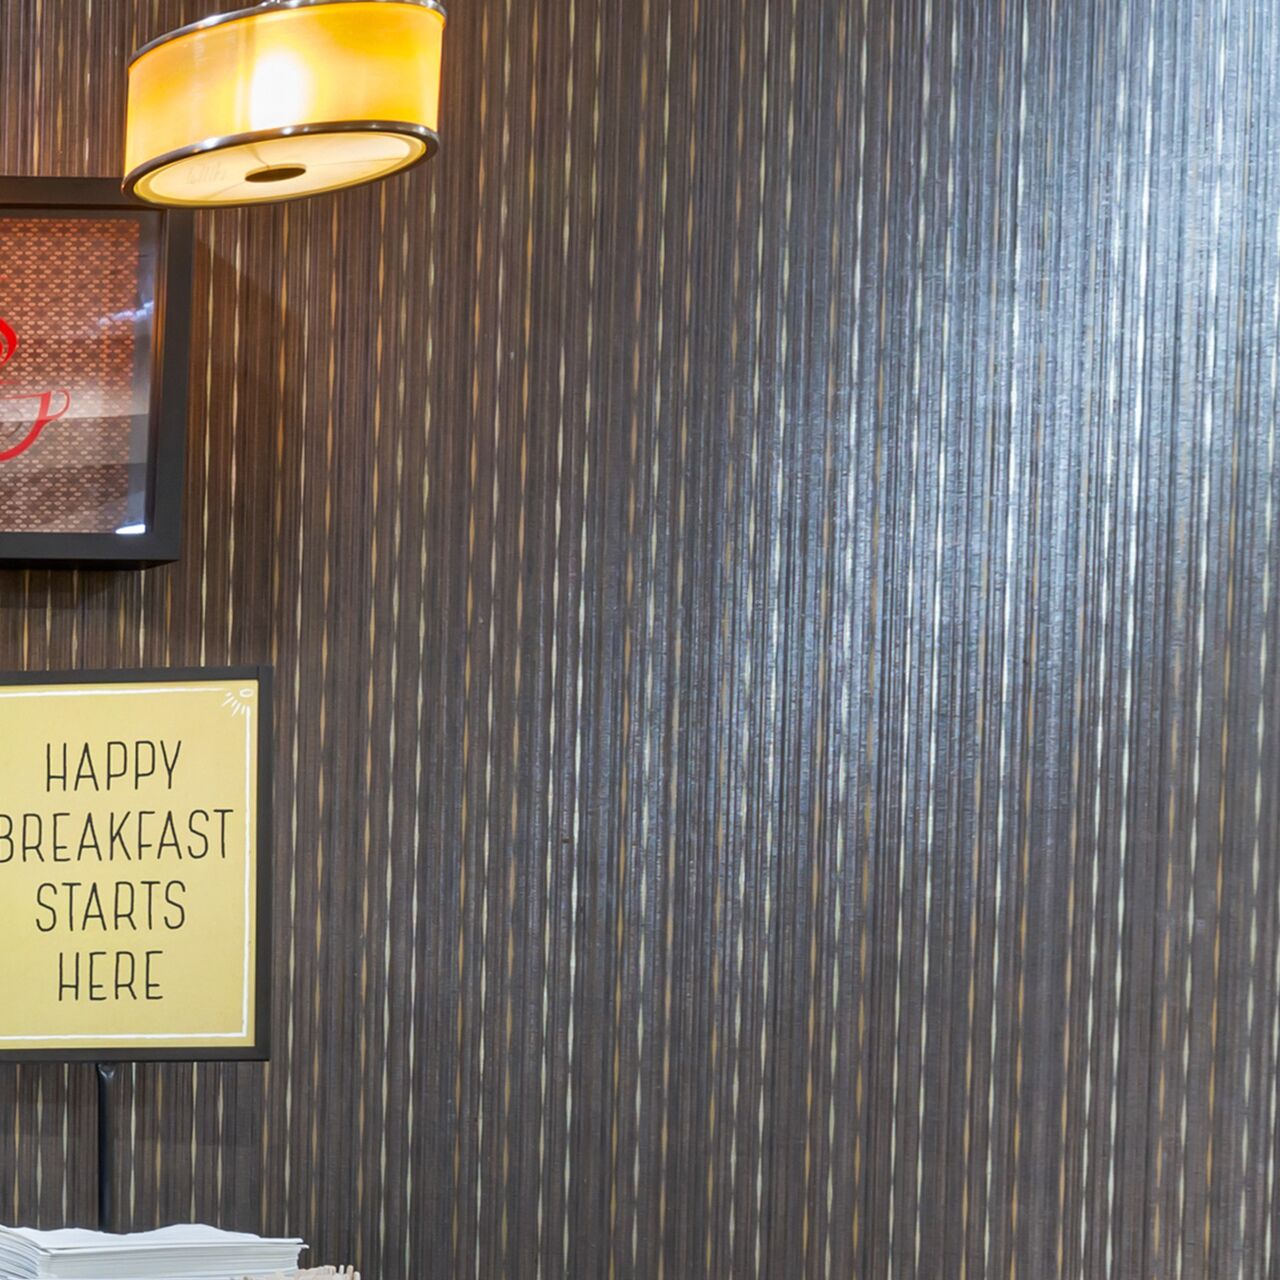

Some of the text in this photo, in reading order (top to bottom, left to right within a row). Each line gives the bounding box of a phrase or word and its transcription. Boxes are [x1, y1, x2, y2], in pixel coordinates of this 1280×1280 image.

[46, 740, 182, 792] HAPPY
[36, 880, 187, 932] STARTS
[58, 951, 163, 1001] HERE
